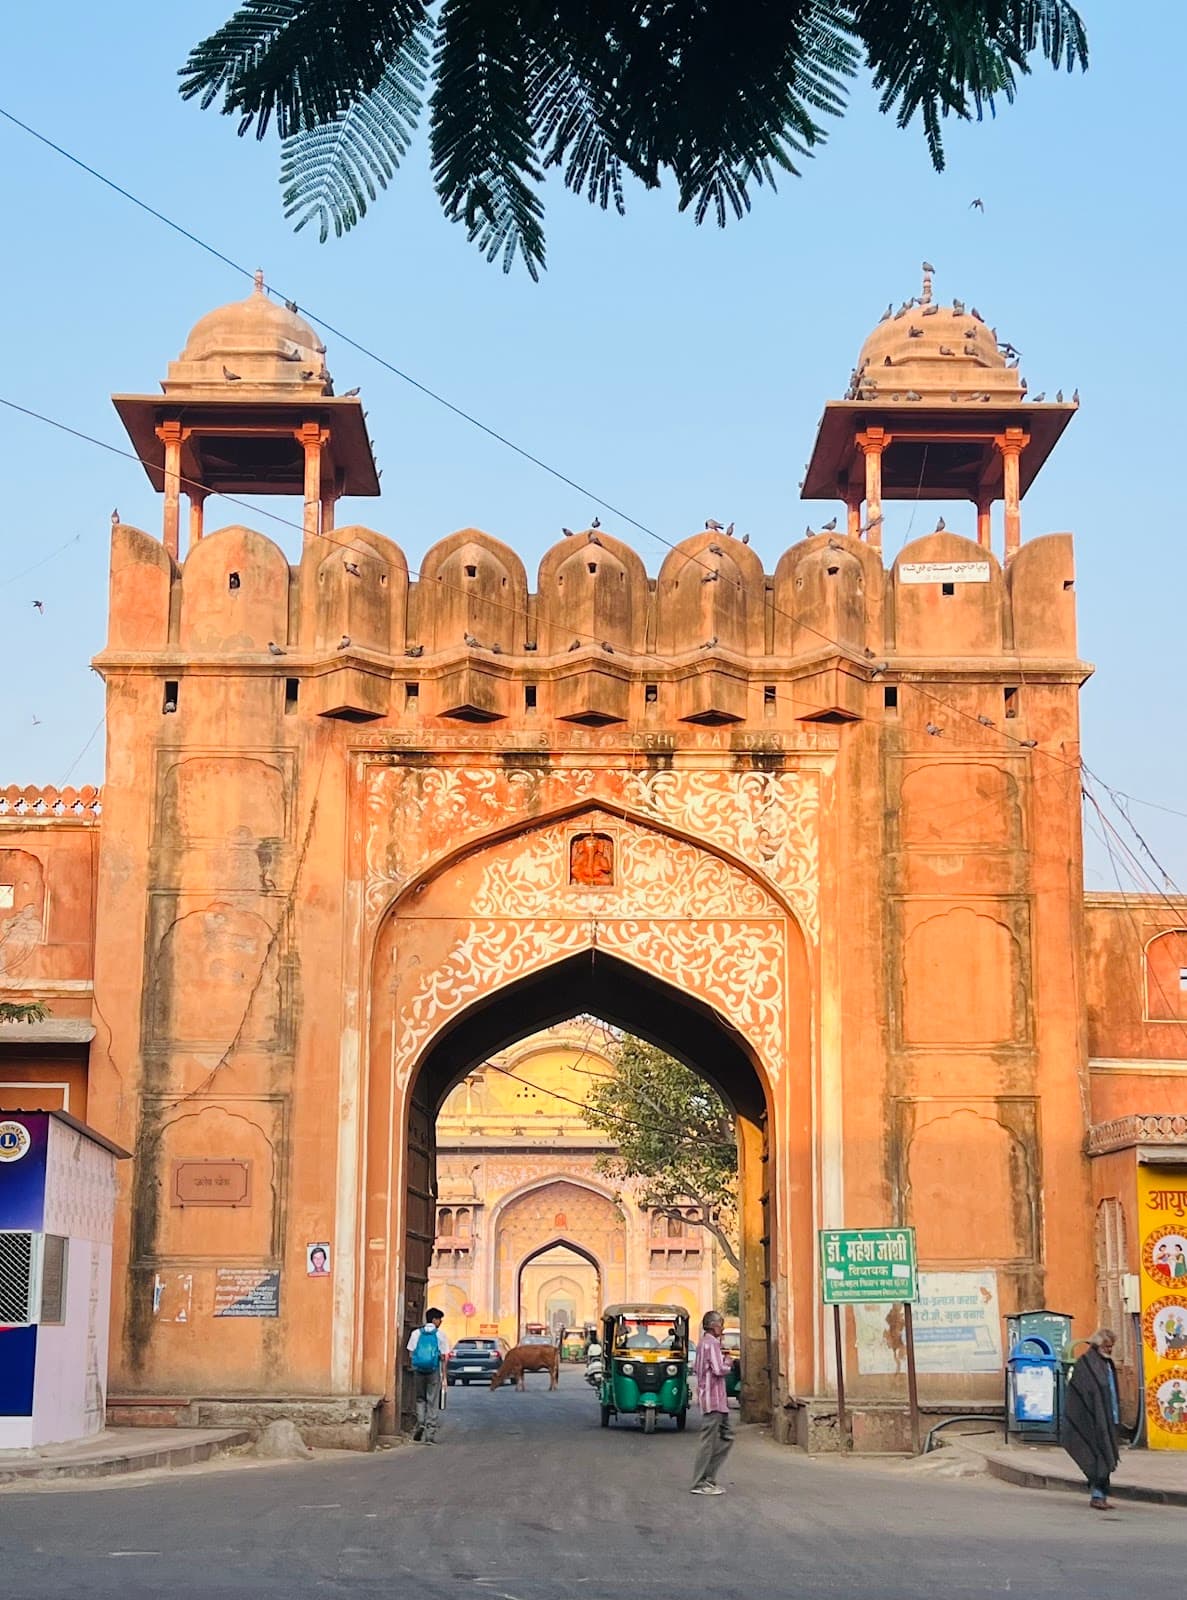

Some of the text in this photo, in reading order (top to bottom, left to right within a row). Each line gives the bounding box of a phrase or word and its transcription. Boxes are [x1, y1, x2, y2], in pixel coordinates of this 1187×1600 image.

[695, 731, 721, 747] KA
[827, 1233, 907, 1262] डॉ. महेश जोशी
[848, 1264, 889, 1276] विधायक
